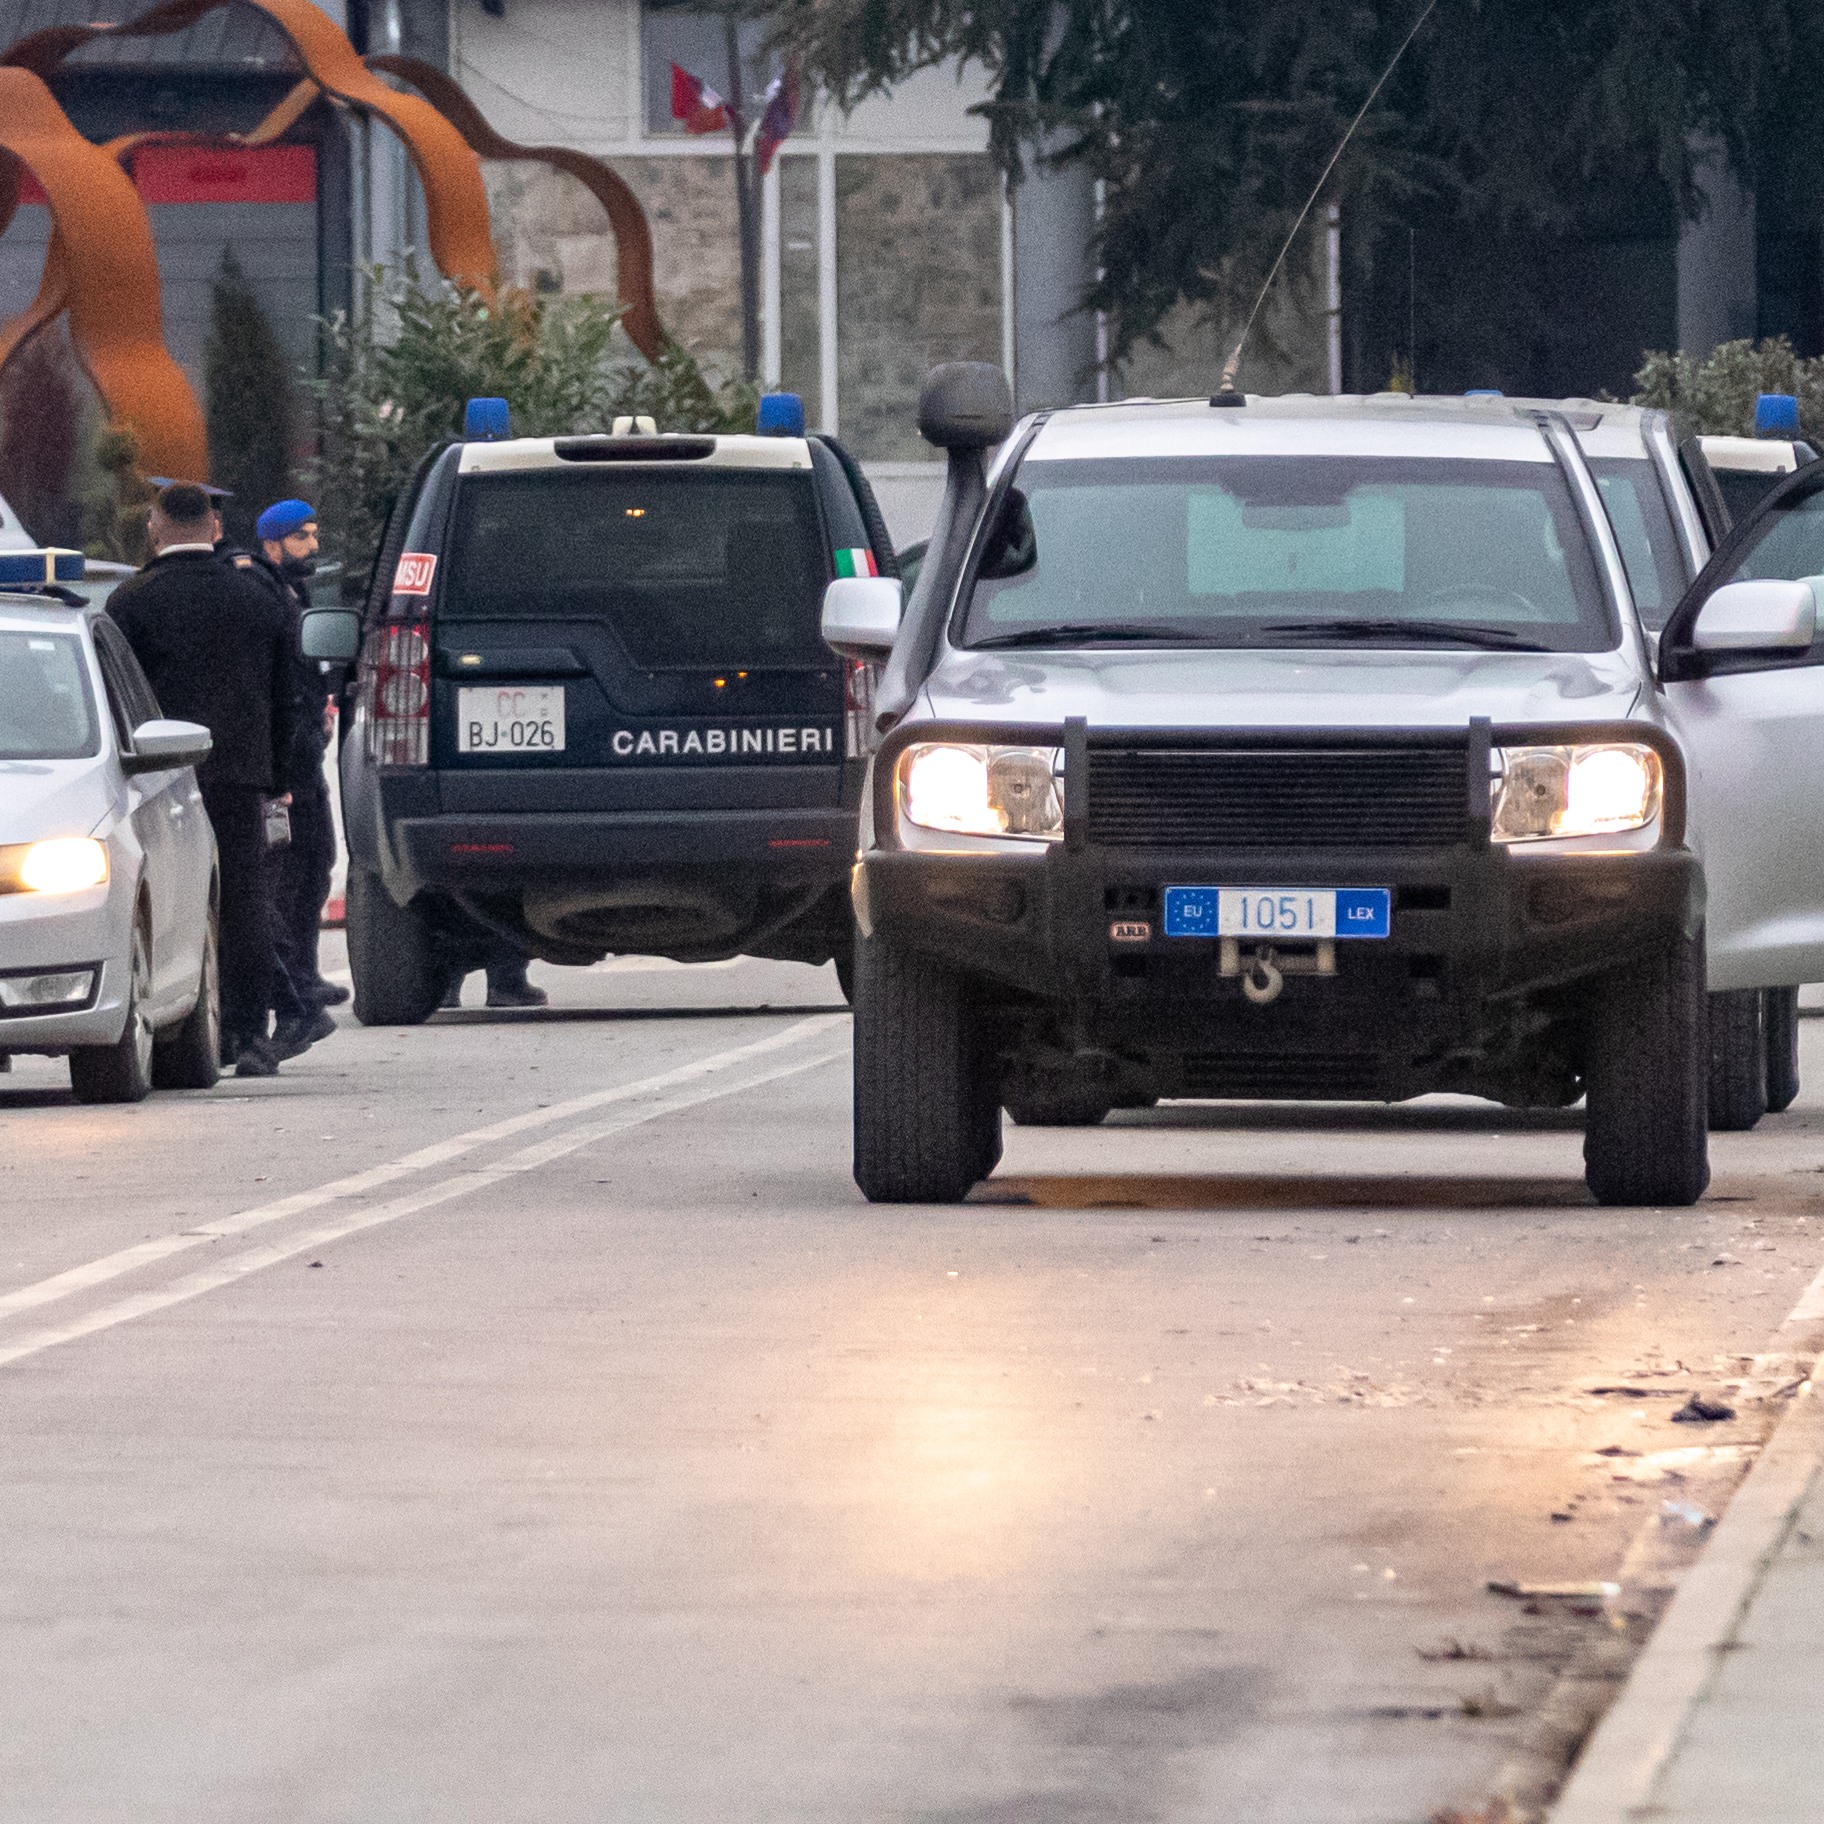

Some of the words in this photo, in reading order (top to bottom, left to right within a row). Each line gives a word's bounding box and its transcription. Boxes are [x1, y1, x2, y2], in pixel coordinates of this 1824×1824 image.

[395, 561, 430, 586] MSU
[612, 728, 833, 755] CARABINIERI
[1183, 905, 1203, 918] EU
[1240, 896, 1314, 930] 1051
[1348, 906, 1375, 920] LEX
